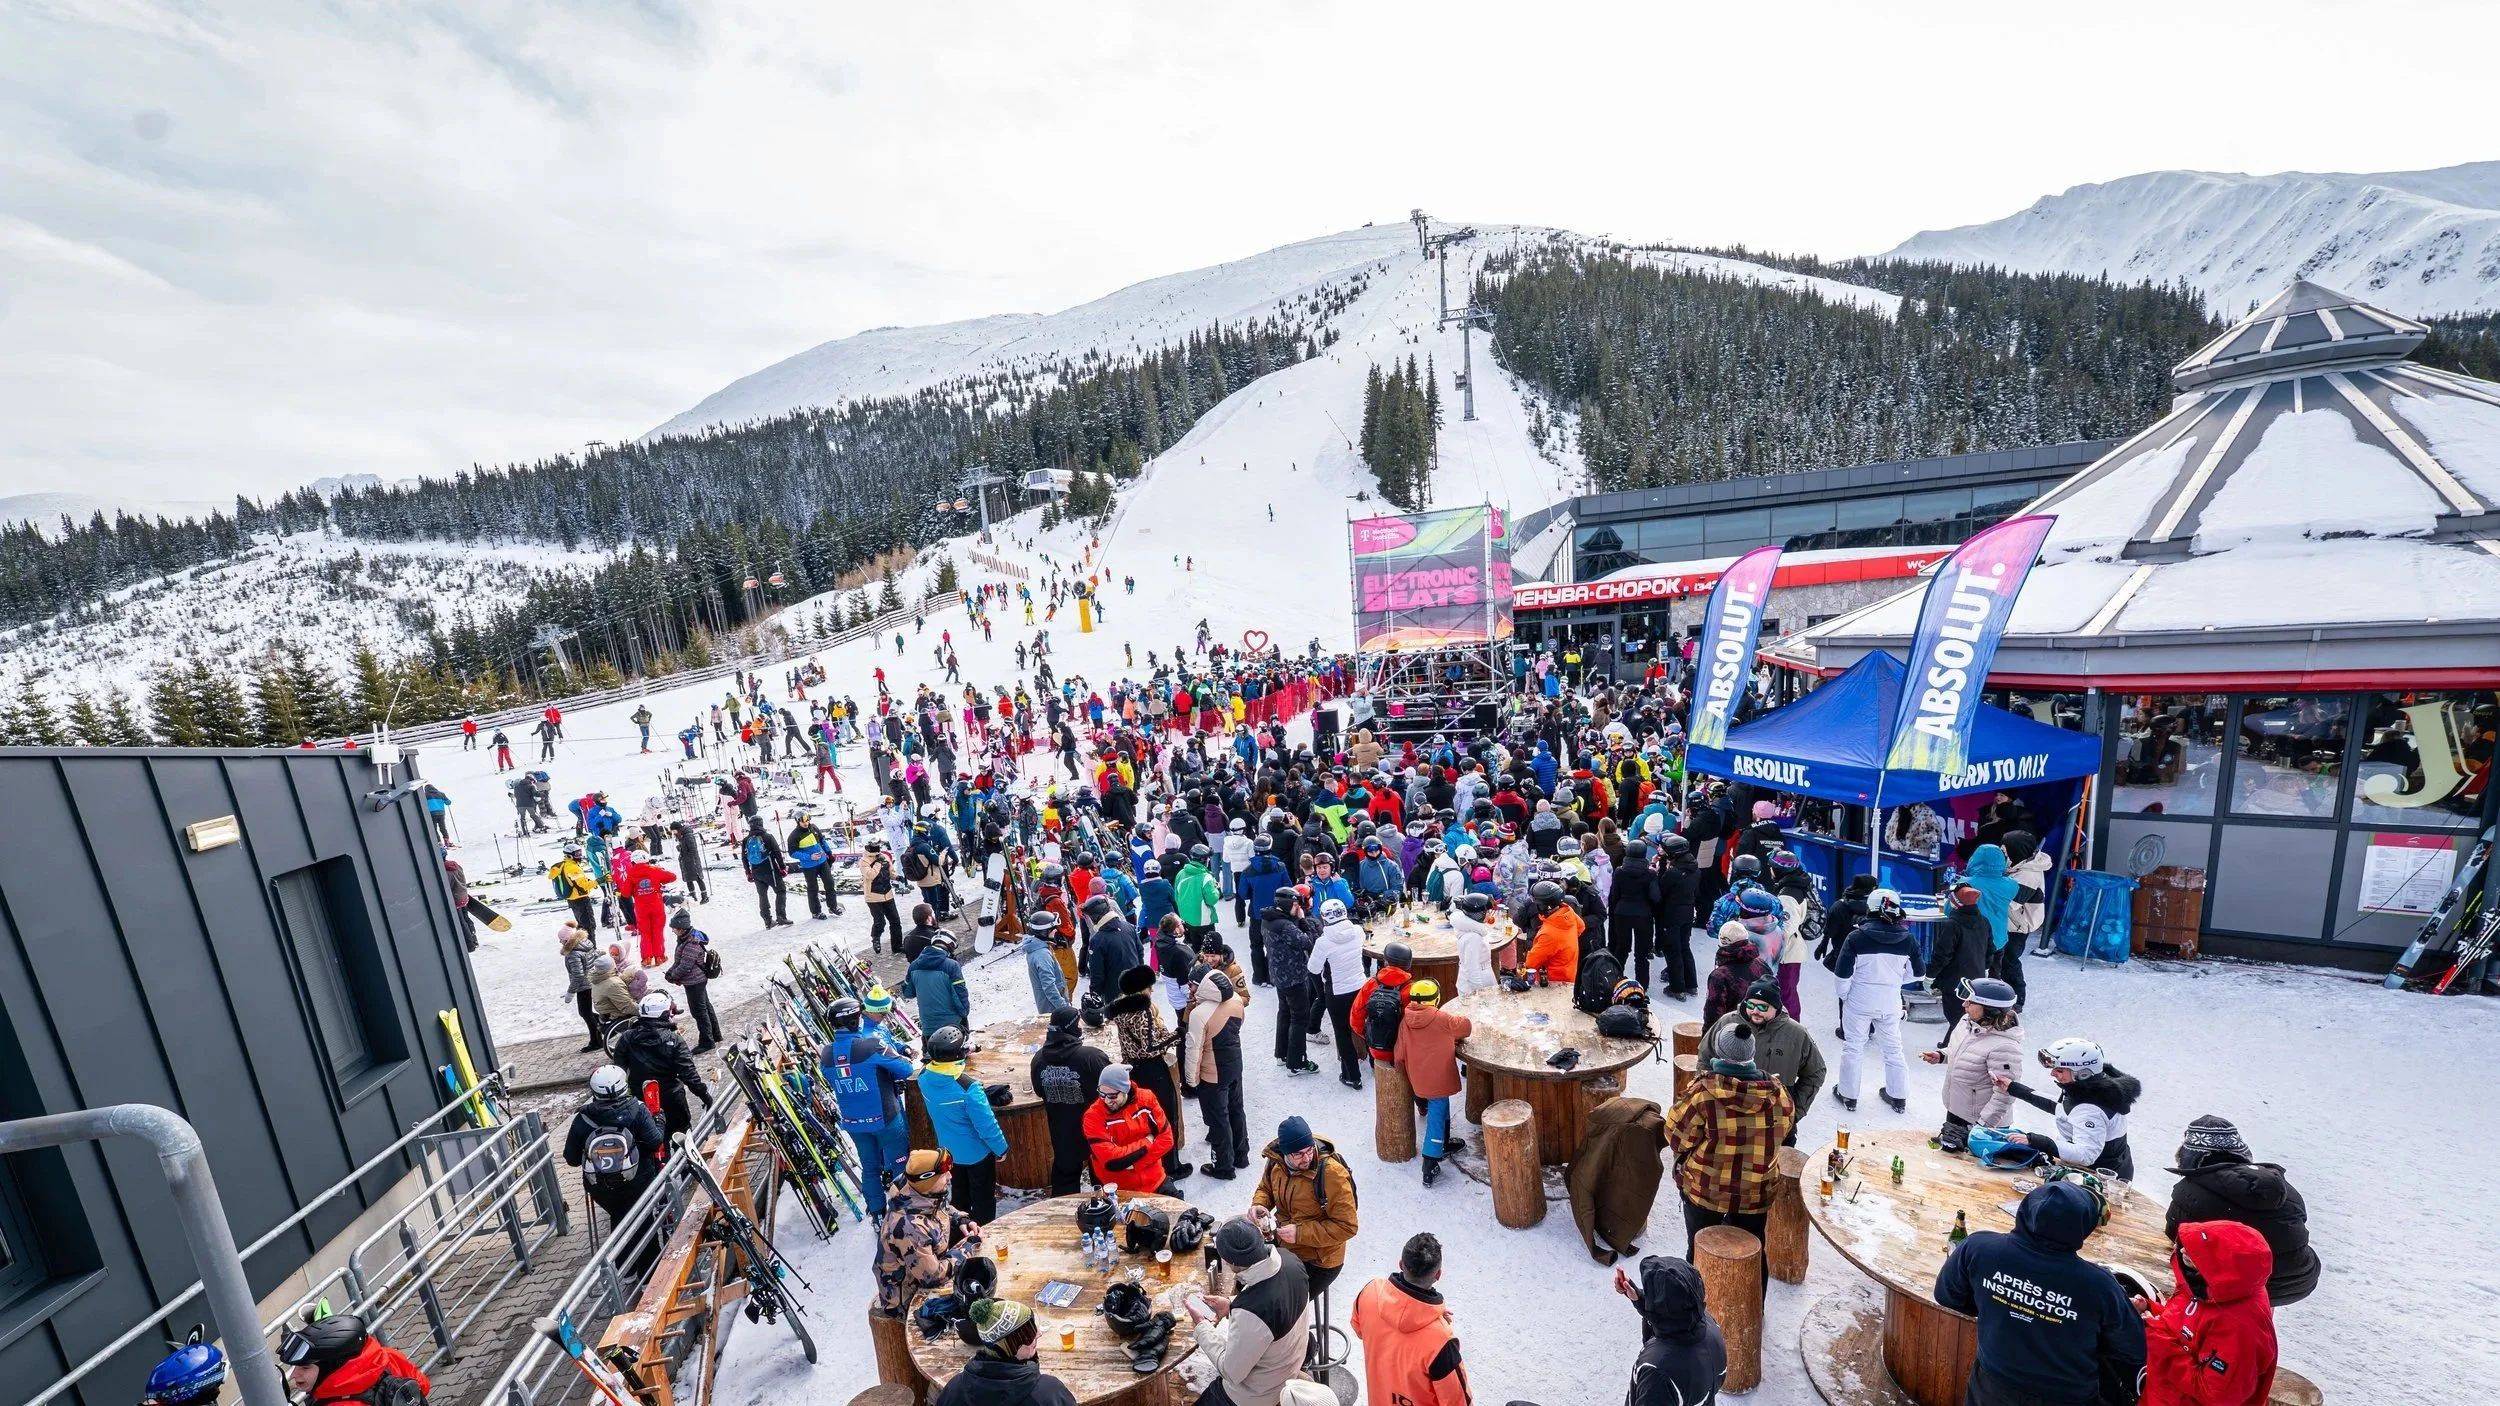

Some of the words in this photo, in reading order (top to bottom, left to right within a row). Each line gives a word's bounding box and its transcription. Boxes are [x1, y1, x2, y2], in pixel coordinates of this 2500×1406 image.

[1907, 560, 1926, 569] WC
[1363, 566, 1479, 593] ELECTRONIC
[1364, 586, 1479, 612] BEATS
[1939, 763, 1990, 791] BORN
[1993, 758, 2015, 783] TO
[2017, 753, 2049, 781] MIX
[835, 1077, 868, 1094] ITA
[1982, 1278, 2078, 1320] INSTRUCTOR
[1993, 1271, 2042, 1296] APRÈS
[2046, 1291, 2072, 1307] SKI
